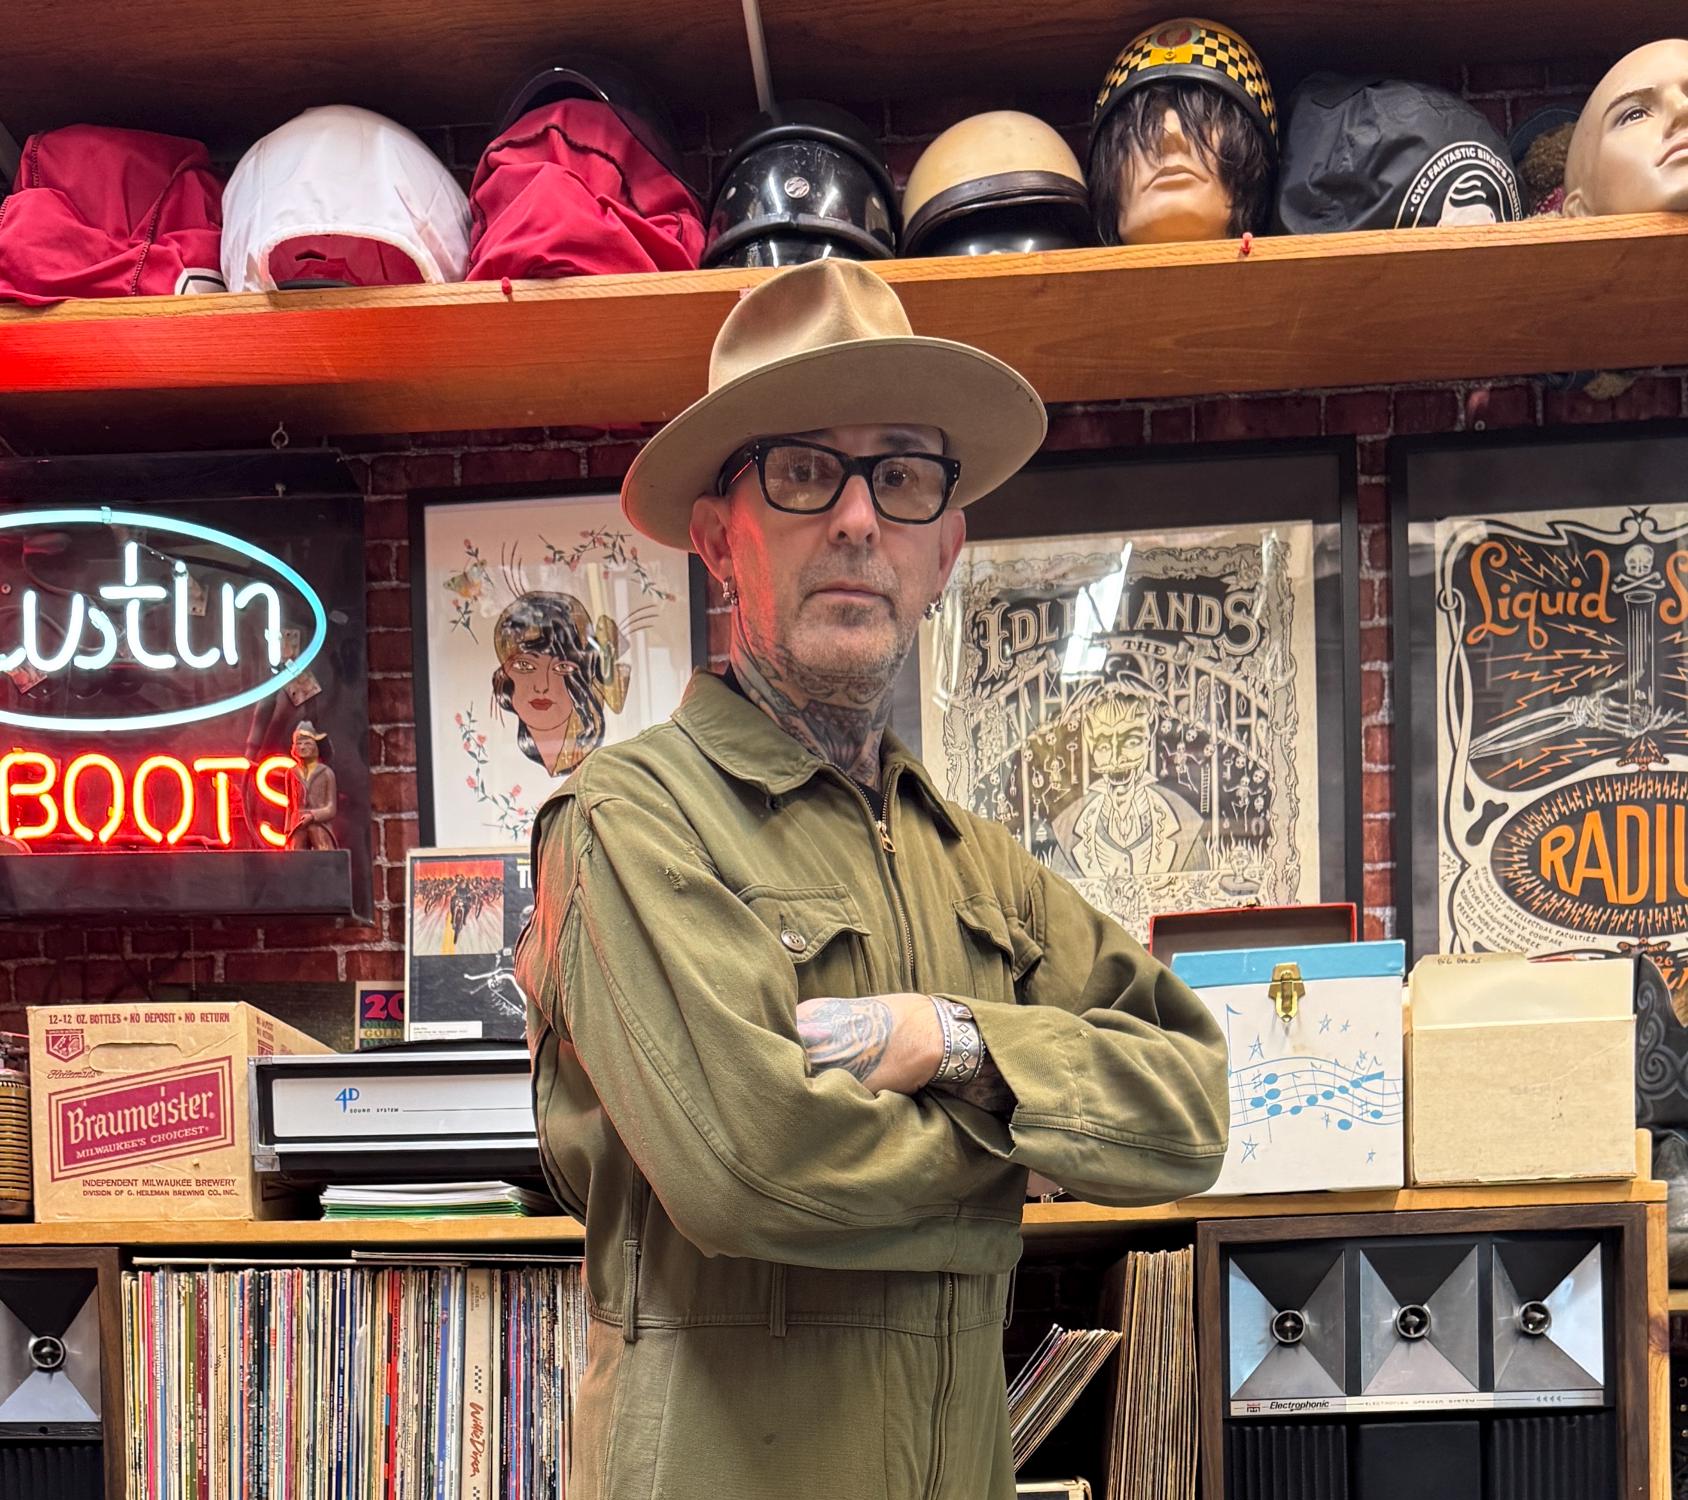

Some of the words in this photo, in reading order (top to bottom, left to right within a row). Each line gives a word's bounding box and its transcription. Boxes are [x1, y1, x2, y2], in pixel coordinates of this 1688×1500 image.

[1410, 178, 1430, 204] CYC
[1427, 147, 1477, 180] FANTASTIC
[0, 541, 282, 672] ustin
[1467, 541, 1617, 651] Liquid
[1123, 639, 1168, 656] THE
[0, 752, 297, 846] BOOTS
[1456, 901, 1484, 935] PREVENTS
[1503, 914, 1527, 931] MANLY
[1506, 904, 1552, 934] INTELLECTUAL
[1555, 930, 1597, 943] FACULTIES
[1517, 934, 1542, 949] FORCE
[49, 1014, 73, 1024] 12-12
[89, 1014, 122, 1023] BOTTLES
[130, 1013, 141, 1023] NO
[144, 1013, 176, 1023] DEPOSIT
[184, 1012, 196, 1023] NO
[200, 1012, 230, 1022] RETURN
[67, 1086, 214, 1144] Braumeister
[76, 1138, 147, 1160] MILWAUKEE'S
[150, 1126, 205, 1144] CHOICEST
[82, 1179, 138, 1187] INDEPENDENT
[142, 1179, 192, 1187] MILWAUKEE
[195, 1179, 237, 1187] BREWERY
[1269, 1400, 1330, 1412] Electrophonic
